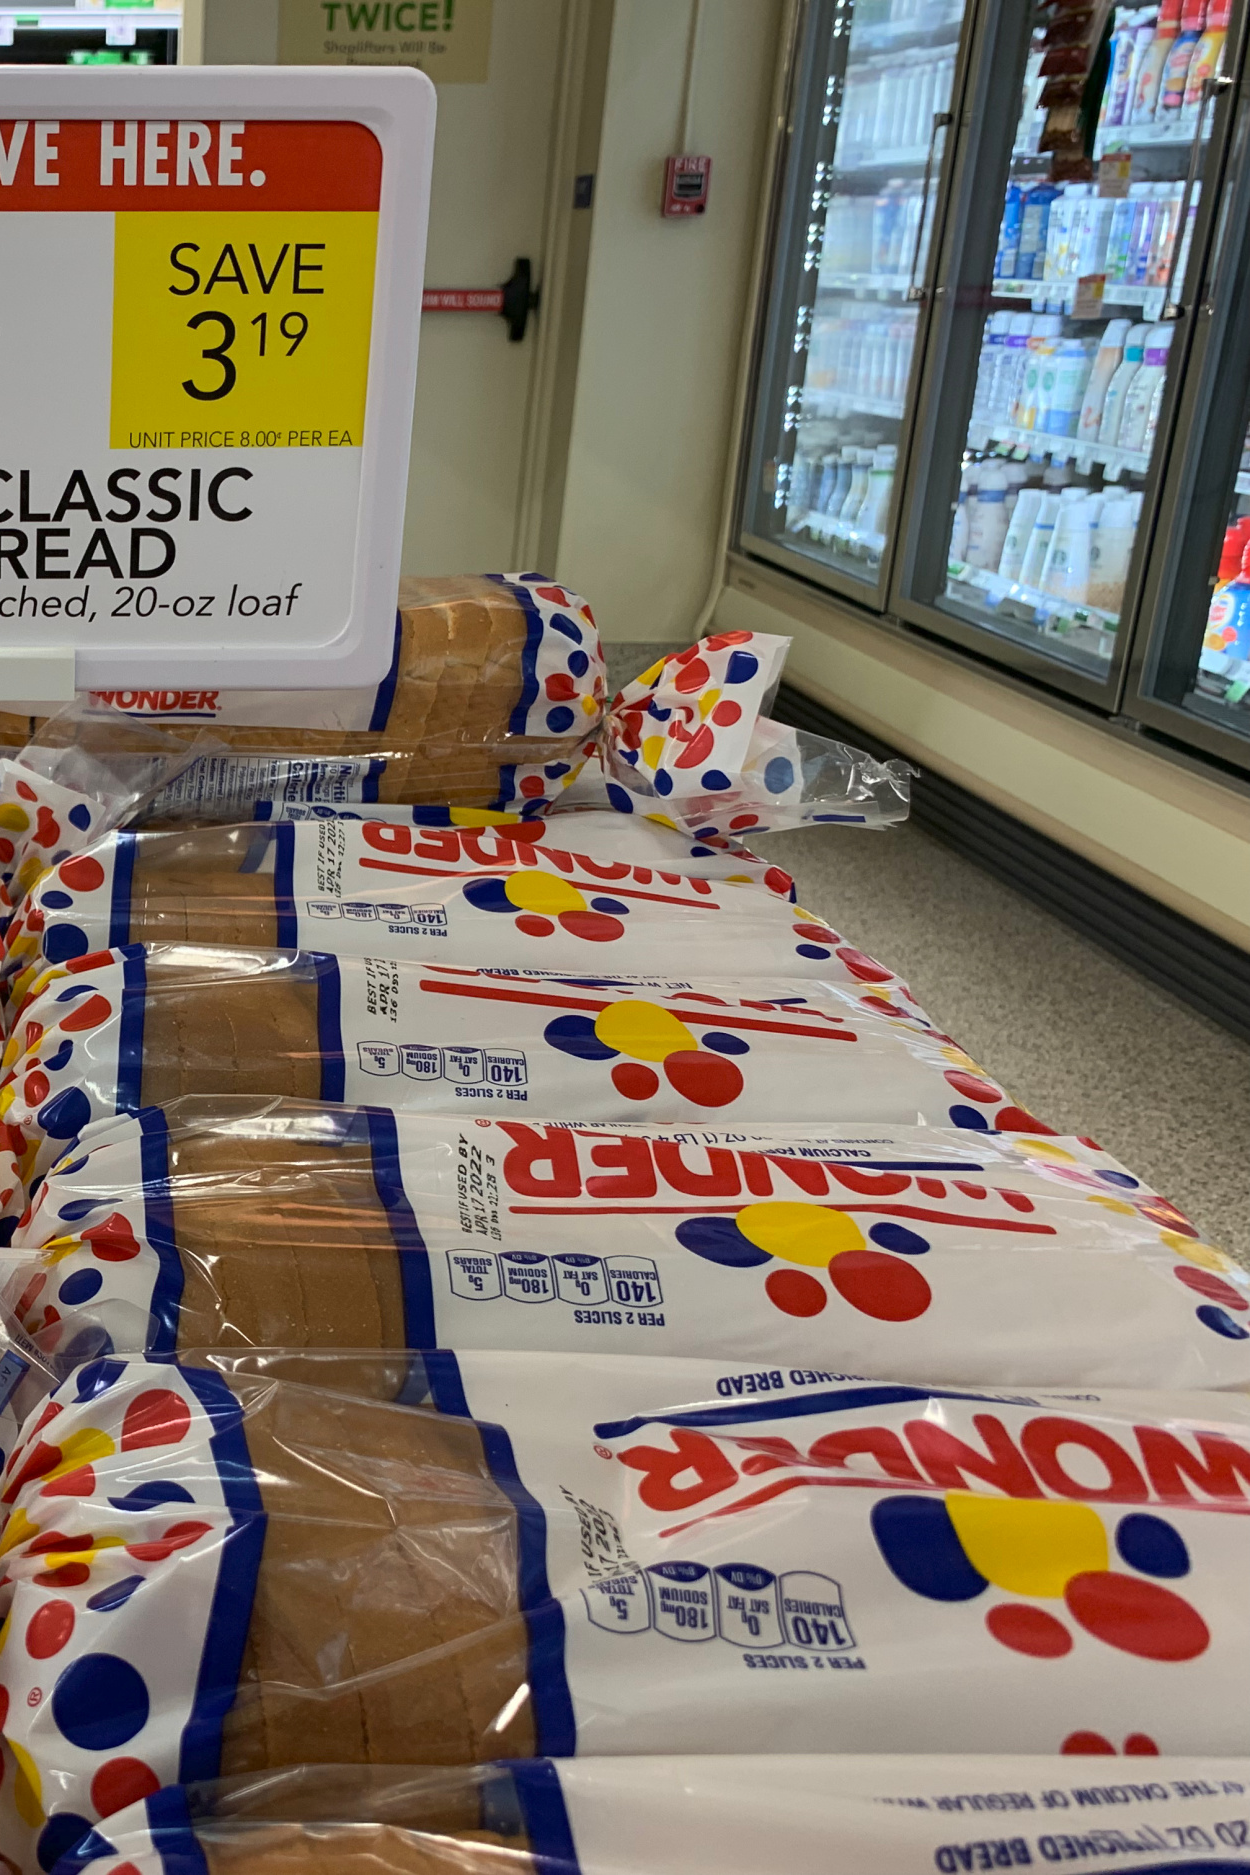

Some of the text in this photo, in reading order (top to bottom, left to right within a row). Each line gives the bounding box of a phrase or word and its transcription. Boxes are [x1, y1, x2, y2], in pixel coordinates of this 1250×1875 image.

[322, 0, 453, 31] TWICE!
[100, 120, 266, 187] HERE.
[168, 242, 326, 296] SAVE
[129, 432, 175, 448] UNIT
[180, 431, 235, 448] PRICE
[287, 431, 322, 447] PER
[328, 430, 352, 446] EA
[111, 585, 216, 618] 20-oz
[227, 583, 302, 618] loaf
[88, 691, 218, 711] WONDER
[288, 763, 304, 802] Calorie
[334, 765, 352, 803] Nutriti
[317, 865, 325, 891] BEST
[326, 847, 336, 893] APR 17
[417, 914, 443, 924] 140
[388, 925, 447, 937] PER SLICES
[367, 980, 377, 1015] BEST
[487, 1056, 524, 1066] CALORIES
[491, 1065, 523, 1083] 140
[455, 1087, 527, 1101] PER SLICES
[457, 1133, 468, 1199] USED BY
[470, 1145, 483, 1196] 2022
[460, 1265, 490, 1274] TOTAL
[507, 1267, 548, 1278] SODIUM
[610, 1270, 656, 1280] CALORIES
[509, 1277, 549, 1294] 180mg
[616, 1280, 656, 1302] 140
[573, 1310, 665, 1326] PER 2 SLICES
[716, 1370, 785, 1396] BREAD
[730, 1571, 743, 1583] DV
[659, 1587, 708, 1605] SODIUM
[726, 1595, 769, 1614] SAT FAT
[660, 1600, 708, 1629] 180mg
[783, 1598, 843, 1618] CALORIES
[792, 1616, 846, 1646] 140
[743, 1654, 866, 1670] PER 2 SLICES
[934, 1838, 1033, 1873] BREAD
